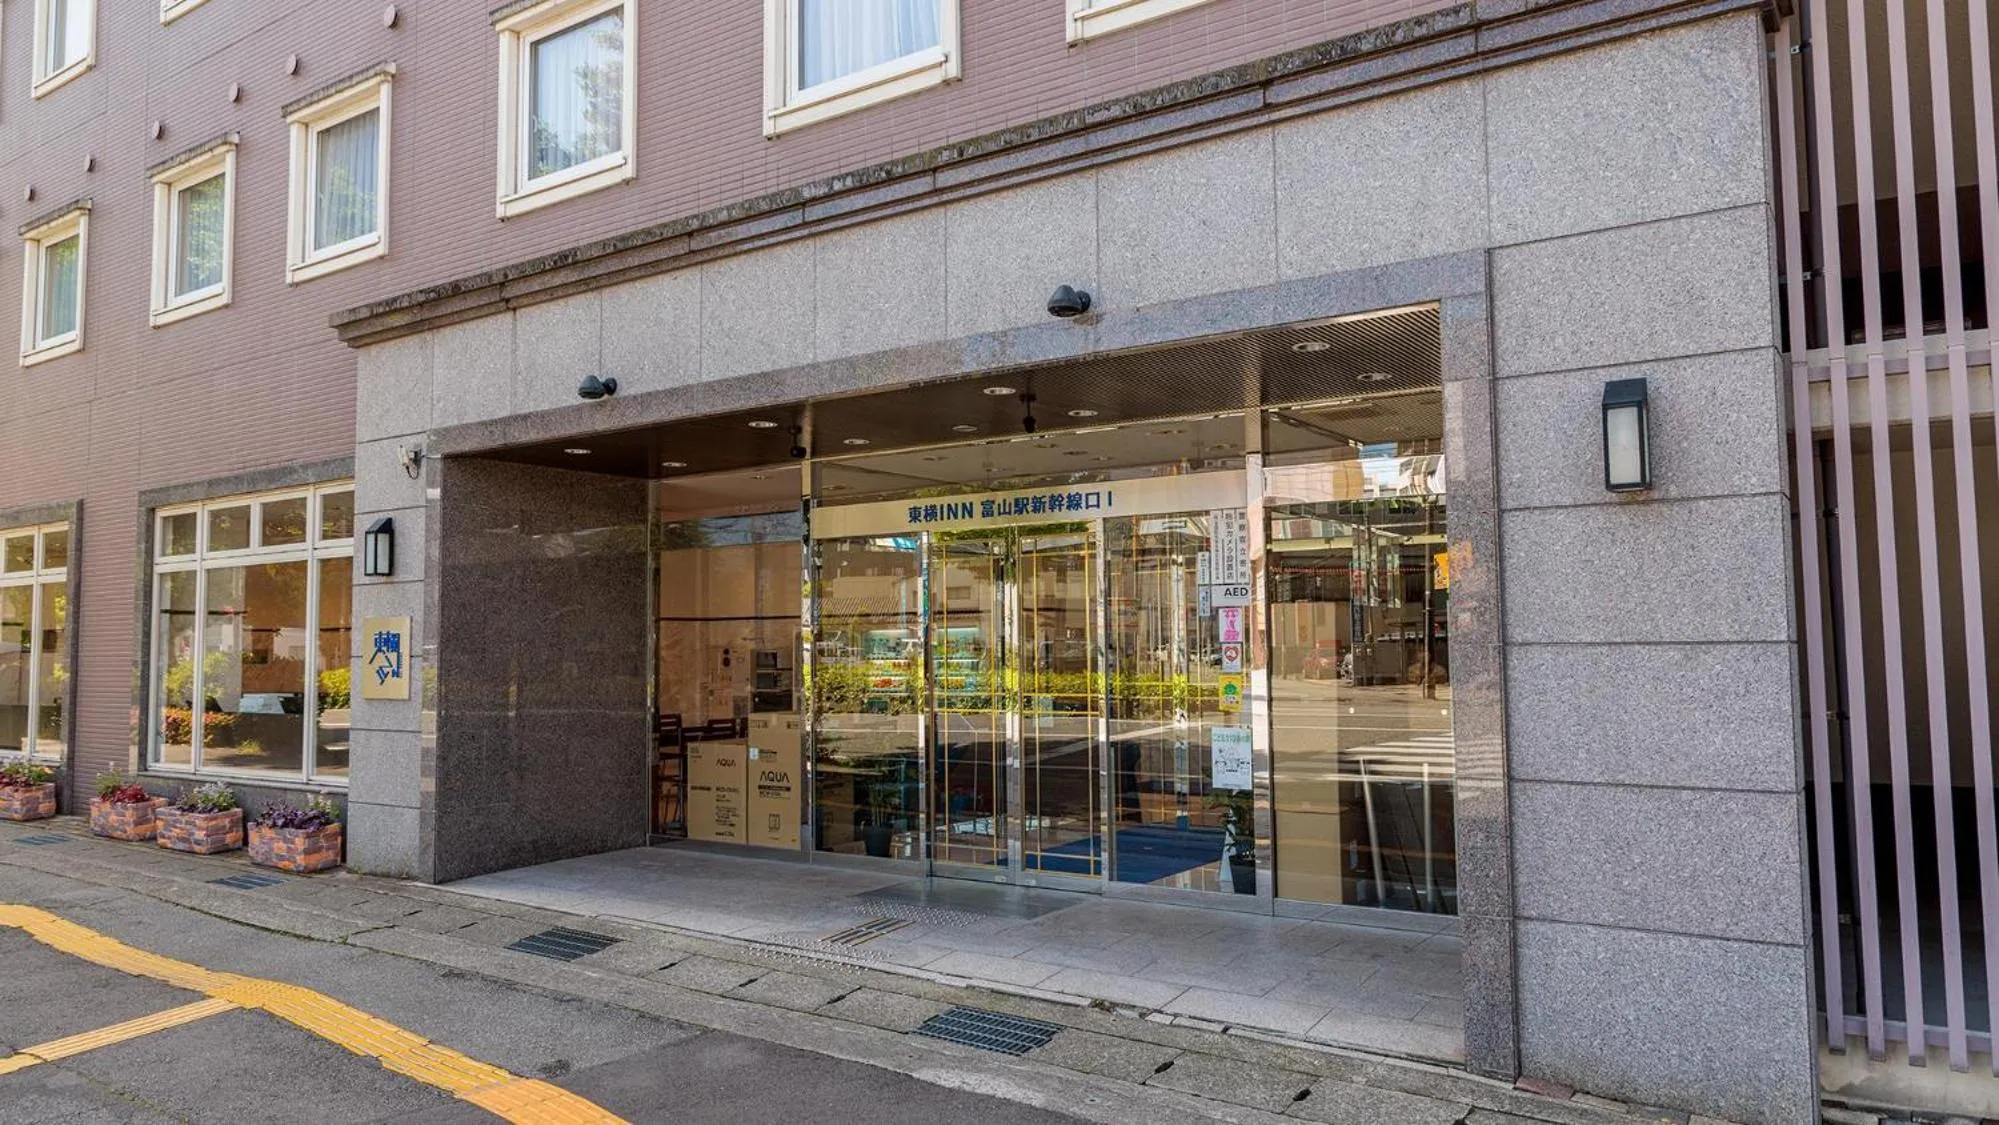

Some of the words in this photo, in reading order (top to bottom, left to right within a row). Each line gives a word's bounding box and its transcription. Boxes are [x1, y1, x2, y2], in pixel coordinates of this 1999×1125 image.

[908, 501, 974, 523] 東横INN
[980, 491, 1101, 518] 富山駅新幹線口
[1224, 587, 1248, 597] AED
[715, 757, 737, 767] AQUA
[759, 771, 790, 783] AQUA
